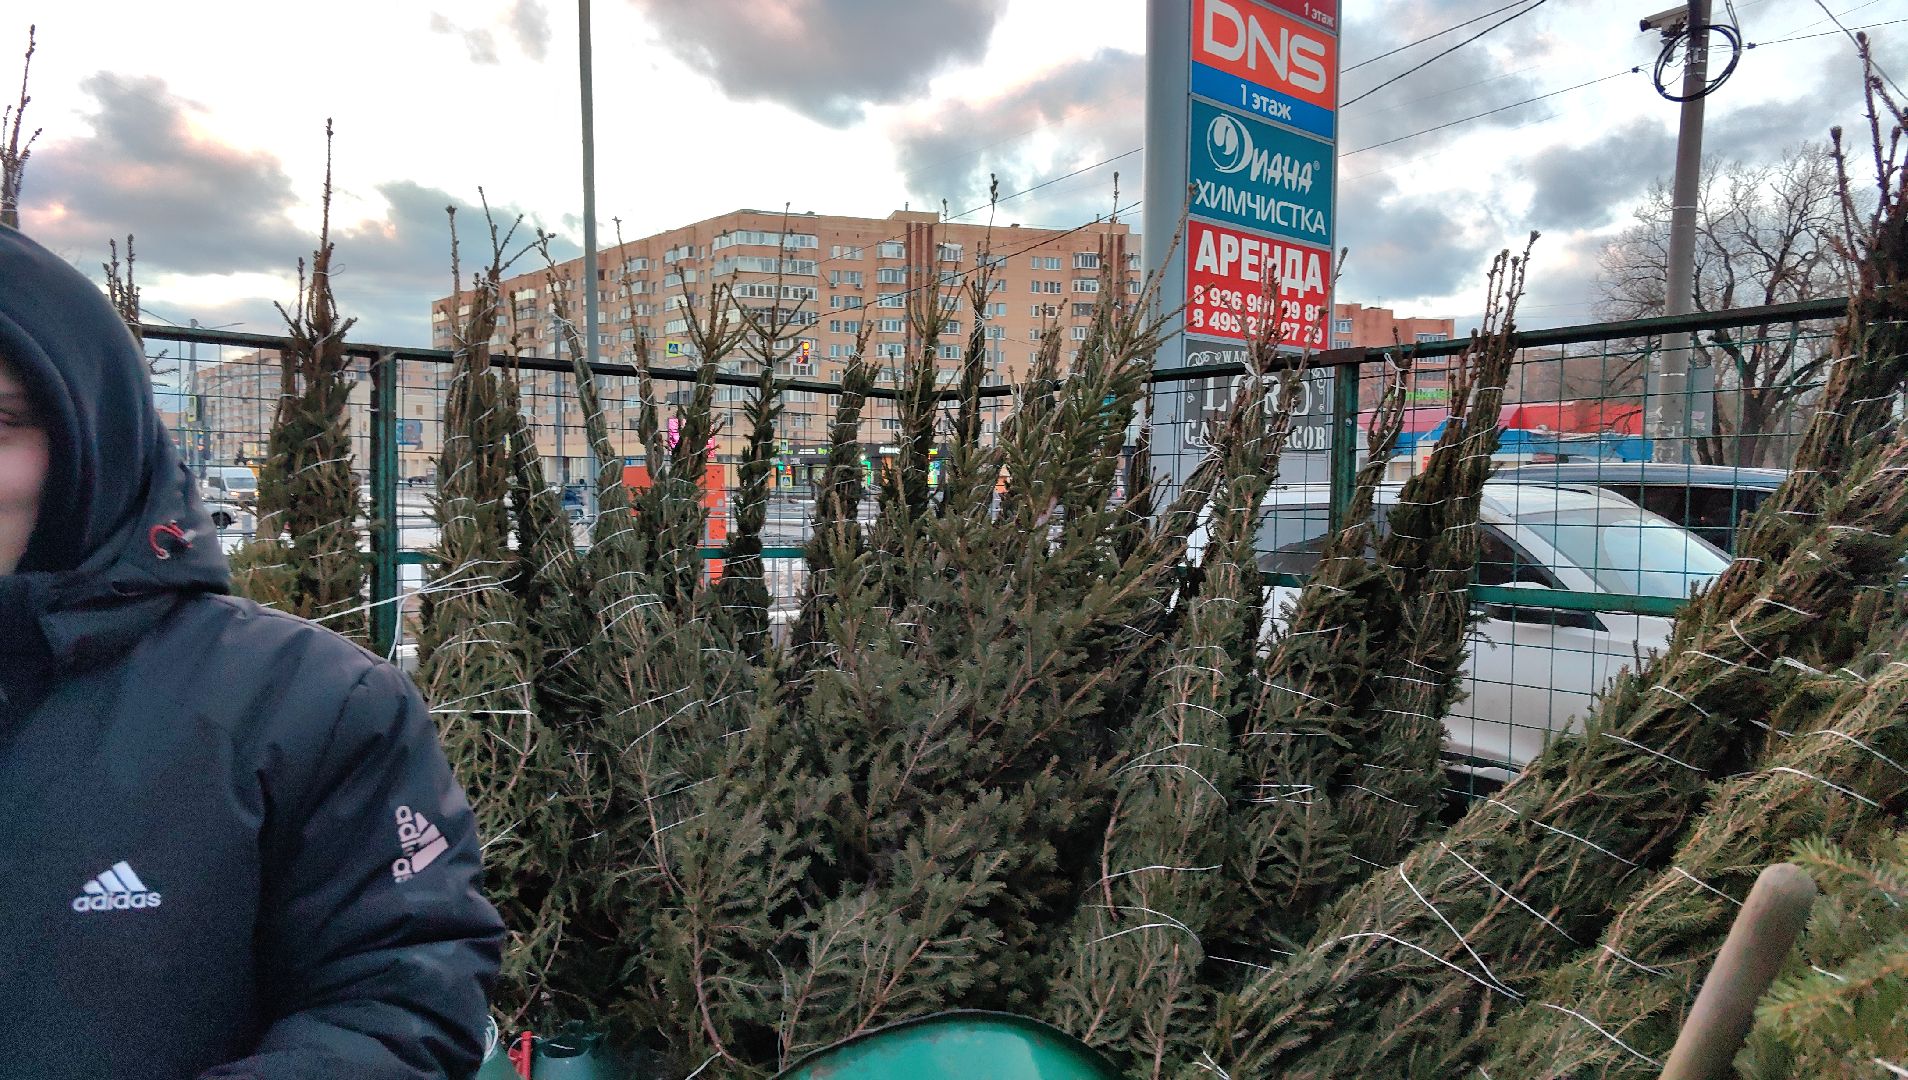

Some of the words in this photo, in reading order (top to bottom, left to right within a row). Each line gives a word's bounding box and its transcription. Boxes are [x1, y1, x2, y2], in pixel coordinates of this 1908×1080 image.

[1303, 2, 1309, 16] 1
[1311, 8, 1335, 28] этаж
[1203, 0, 1327, 94] DNS
[1240, 84, 1247, 106] 1
[1251, 92, 1292, 121] этаж
[1195, 178, 1327, 236] ХИМЧИСТКА
[1194, 229, 1324, 299] АРЕНДА
[1193, 284, 1205, 305] 8
[1193, 308, 1204, 328] 8
[1208, 311, 1241, 333] 495
[392, 805, 421, 884] adia
[73, 891, 162, 912] adidas
